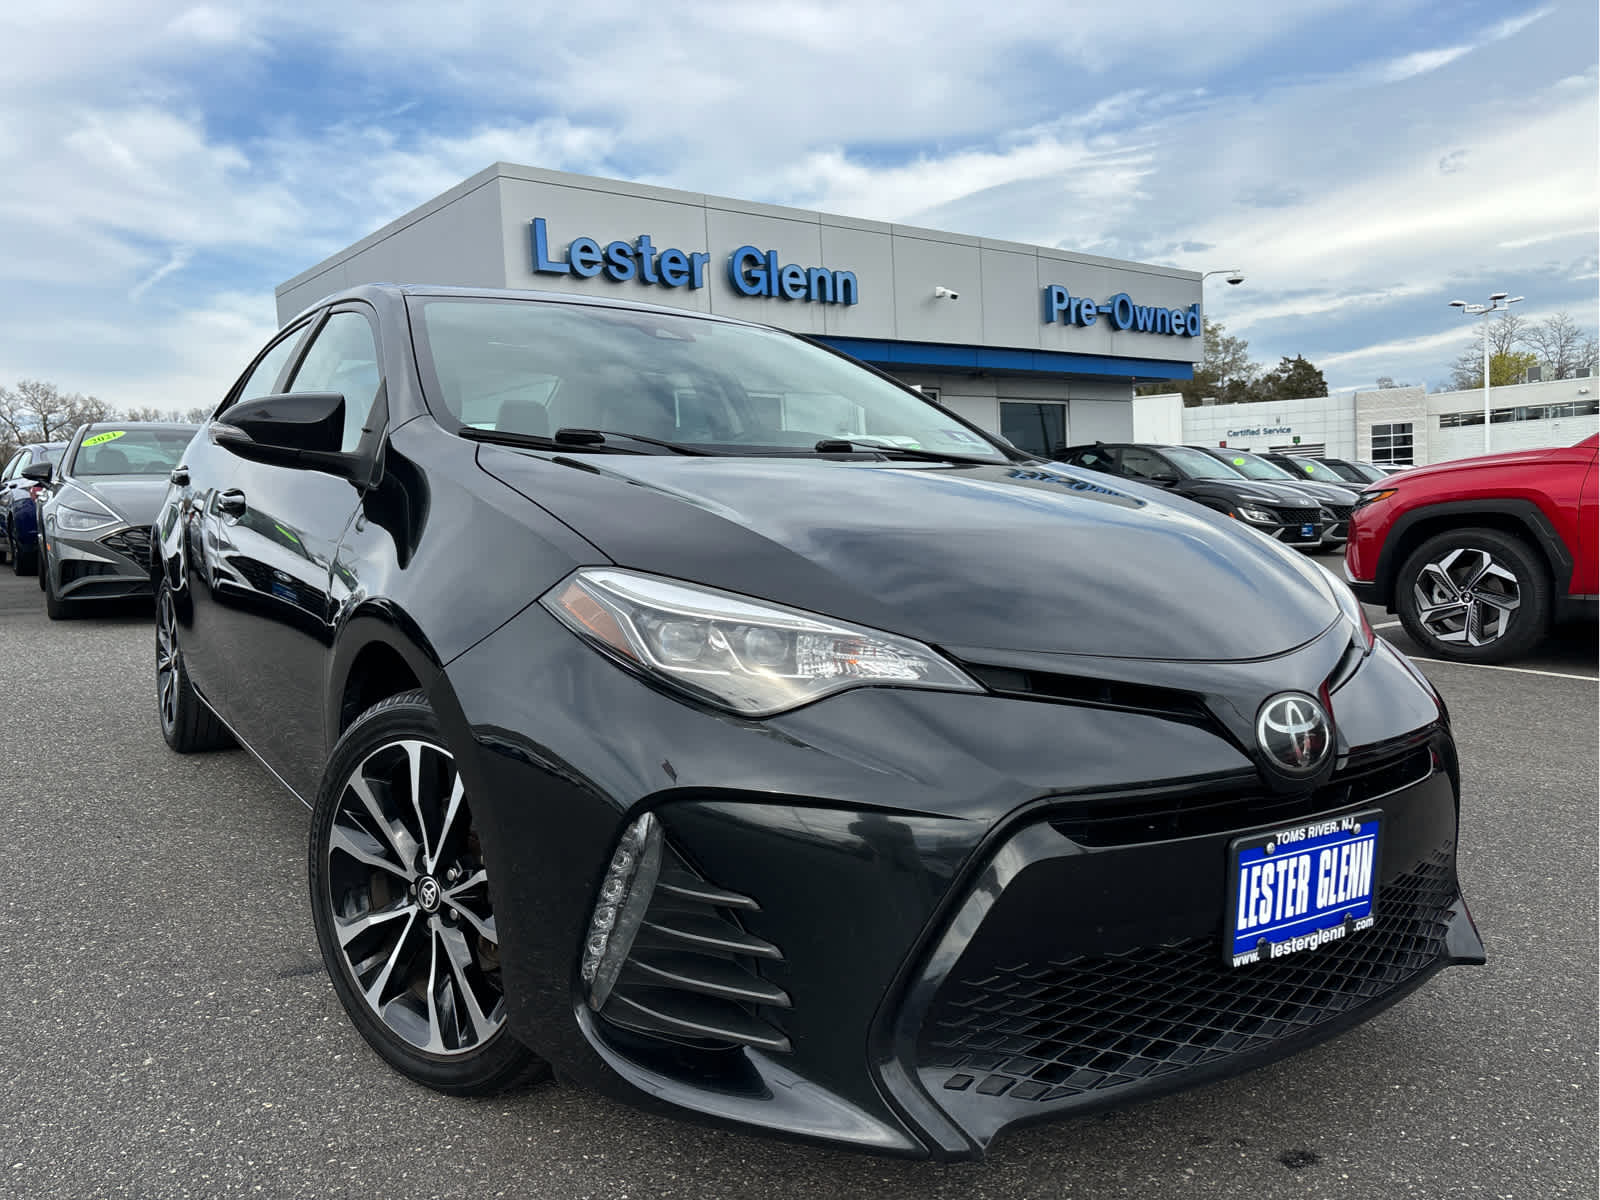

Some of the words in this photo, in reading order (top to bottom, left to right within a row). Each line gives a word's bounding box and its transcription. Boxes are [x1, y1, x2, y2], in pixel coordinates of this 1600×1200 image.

[529, 217, 709, 290] Lester
[727, 245, 859, 306] Glenn
[1043, 284, 1201, 337] Pre-Owned
[93, 431, 116, 444] 2021
[1227, 428, 1260, 437] Certified
[1263, 426, 1291, 435] Service
[1276, 829, 1305, 846] TOMS
[1237, 854, 1311, 931] LESTER
[1316, 839, 1375, 909] GLENN
[1232, 951, 1260, 968] www.
[1270, 925, 1346, 959] lesterglenn
[1353, 916, 1374, 931] .com
